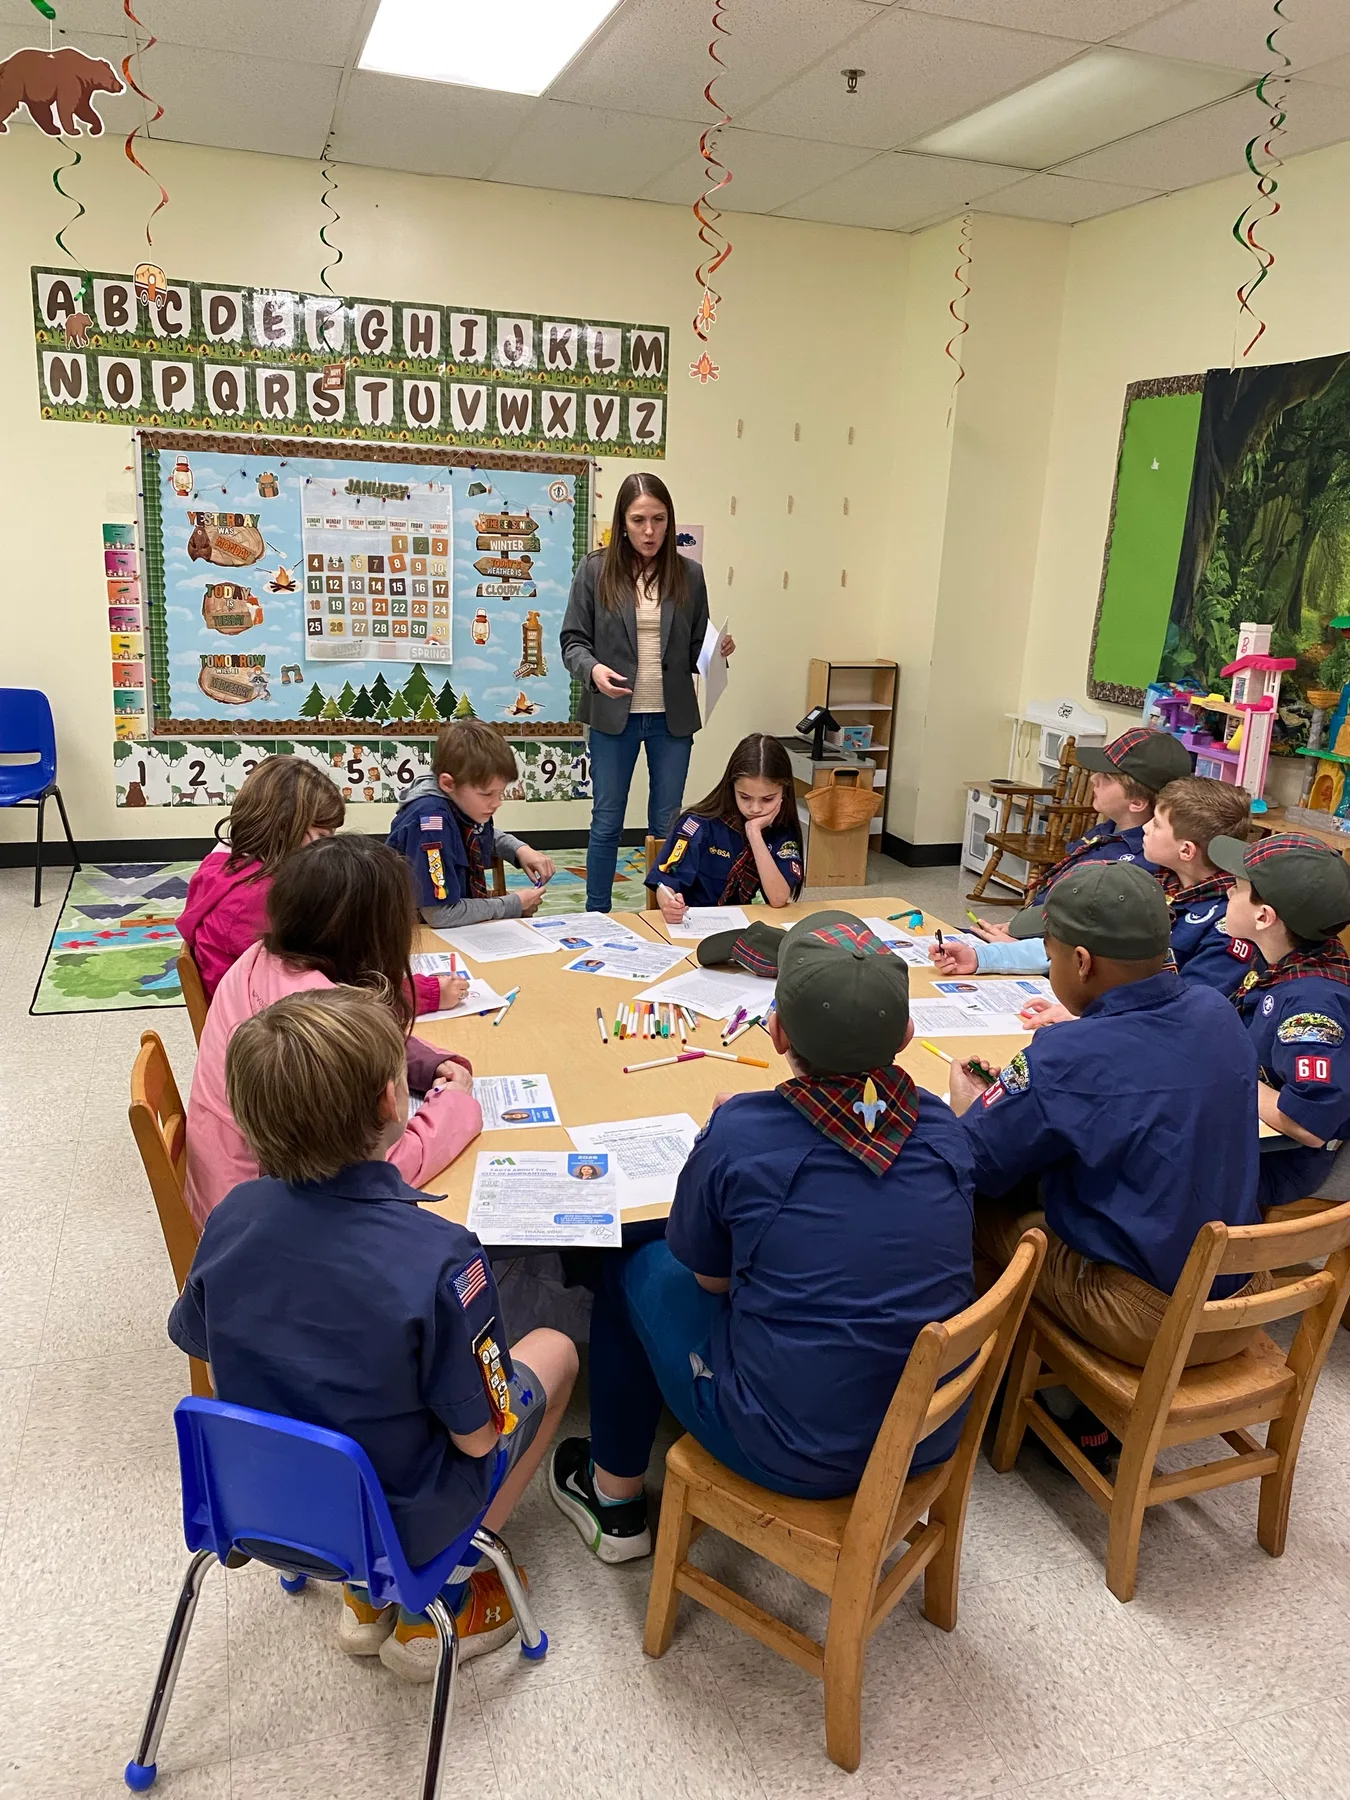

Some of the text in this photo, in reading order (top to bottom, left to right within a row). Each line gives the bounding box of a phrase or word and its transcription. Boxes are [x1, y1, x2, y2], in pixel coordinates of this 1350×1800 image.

[47, 280, 75, 321] A
[103, 285, 129, 327] B
[157, 290, 183, 334] C
[209, 295, 236, 335] D
[262, 301, 286, 341] E
[361, 309, 388, 350] G
[410, 313, 433, 354] H
[460, 319, 478, 357] I
[503, 324, 524, 362] J
[549, 326, 572, 366] K
[594, 331, 615, 368] L
[632, 334, 661, 373] M
[50, 357, 656, 438] N O P Q R S T U V W X Y Z
[345, 479, 409, 501] JANUARY
[187, 511, 260, 528] YESTERDAY
[487, 519, 498, 528] THE
[217, 527, 234, 535] WAS
[216, 537, 251, 559] MONDAY
[398, 539, 443, 552] 1 2 3
[490, 540, 524, 550] WINTER
[312, 558, 443, 572] 4 5 6 7 8 9 10
[490, 559, 521, 568] TODAY'S
[487, 568, 514, 576] WEATHER
[205, 584, 251, 600] TODAY
[311, 580, 446, 594] 11 12 13 14 15 16 17
[485, 584, 521, 596] CLOUDY
[331, 600, 342, 610] 19
[352, 601, 364, 611] 20
[375, 602, 386, 612] 21
[393, 604, 406, 613] 22
[413, 604, 426, 614] 23
[435, 605, 447, 615] 24
[213, 615, 244, 626] TUESDAY
[309, 622, 446, 635] 25 26 27 28 29 30 31
[411, 647, 448, 659] SPRING
[200, 655, 266, 667] TOMORROW
[212, 677, 251, 699] WEDNESDAY
[138, 761, 146, 786] 1
[189, 761, 207, 786] 2
[347, 759, 364, 784] 5
[397, 759, 414, 784] 6
[540, 760, 556, 783] 9
[717, 849, 730, 858] BSA
[1232, 939, 1249, 958] 60
[1298, 1058, 1327, 1079] 60
